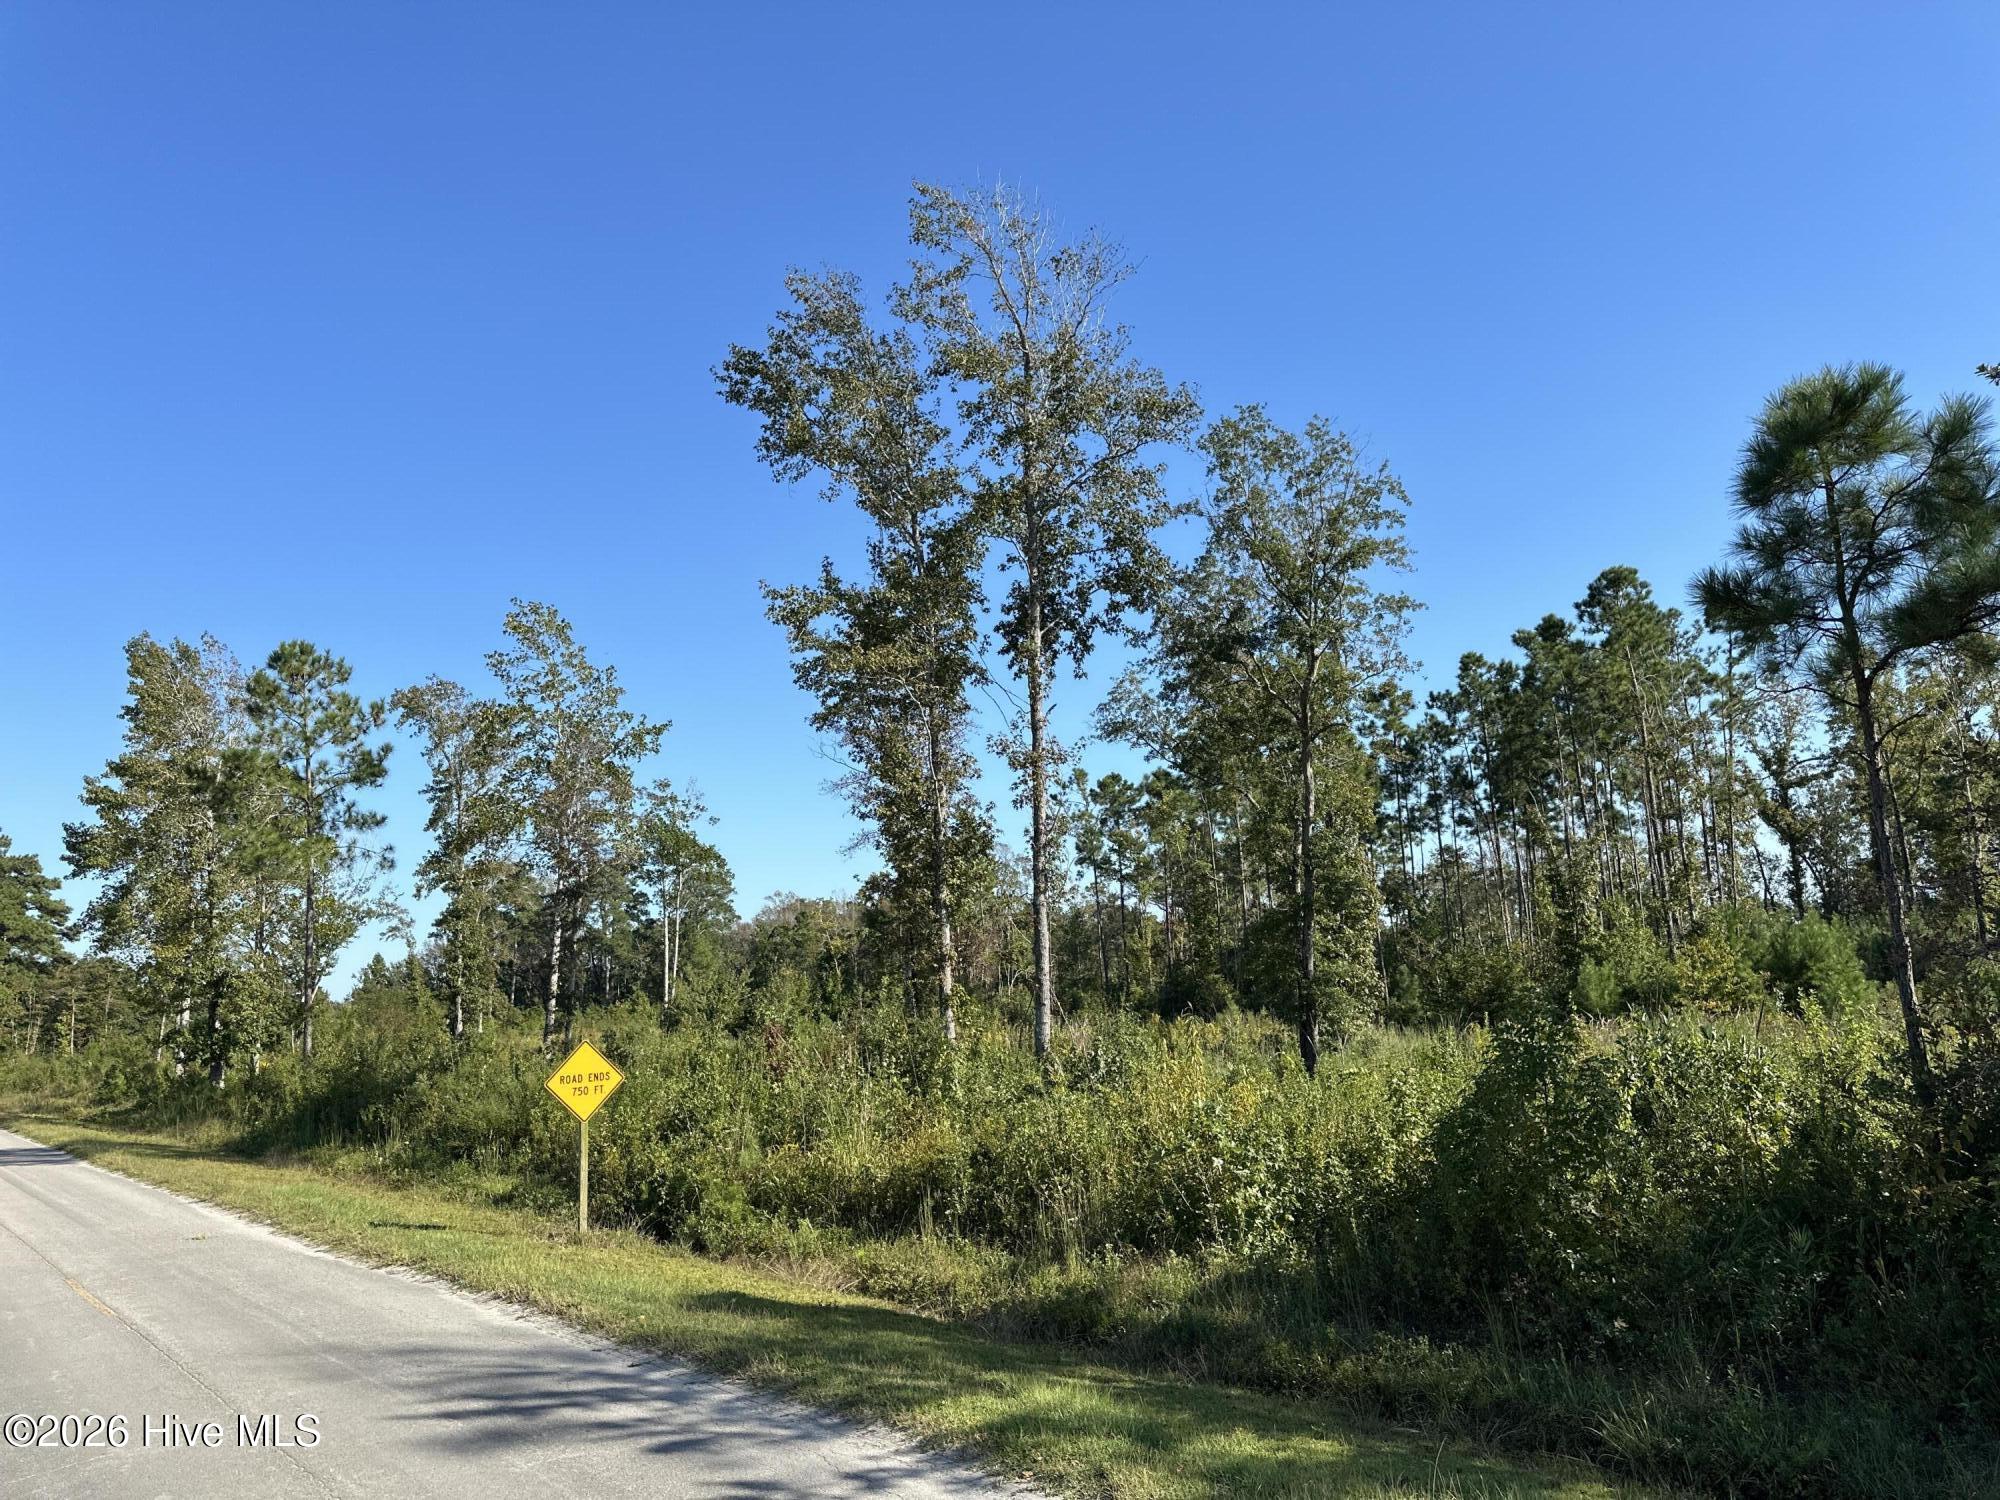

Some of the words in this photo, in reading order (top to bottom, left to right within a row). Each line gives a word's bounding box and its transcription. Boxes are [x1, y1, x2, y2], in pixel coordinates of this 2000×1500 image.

[559, 1074, 583, 1085] ROAD
[588, 1072, 611, 1082] ENDS
[572, 1086, 589, 1097] 750
